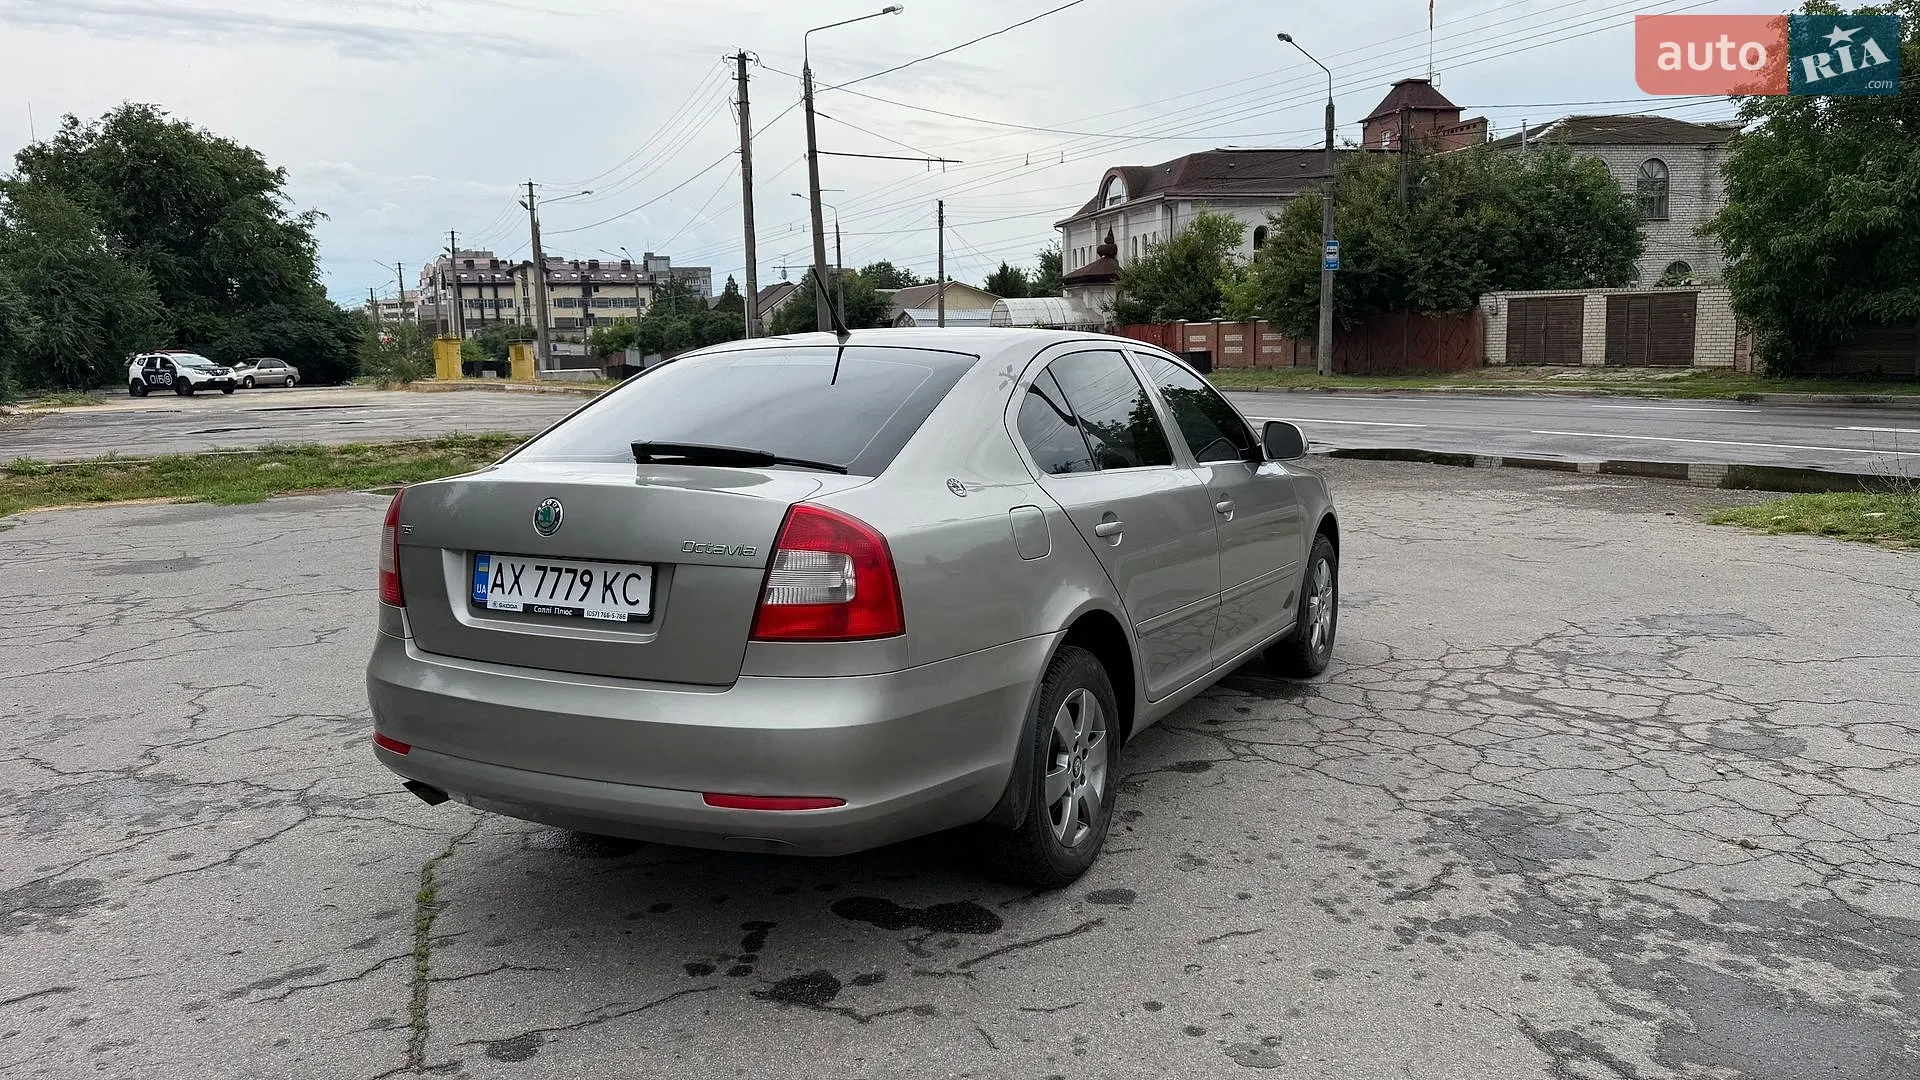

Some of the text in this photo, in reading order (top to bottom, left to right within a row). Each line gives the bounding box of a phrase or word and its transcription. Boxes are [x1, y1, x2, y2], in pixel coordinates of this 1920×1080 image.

[681, 540, 757, 557] Octavia
[476, 584, 487, 594] UA
[490, 562, 642, 606] AX 7779 KC
